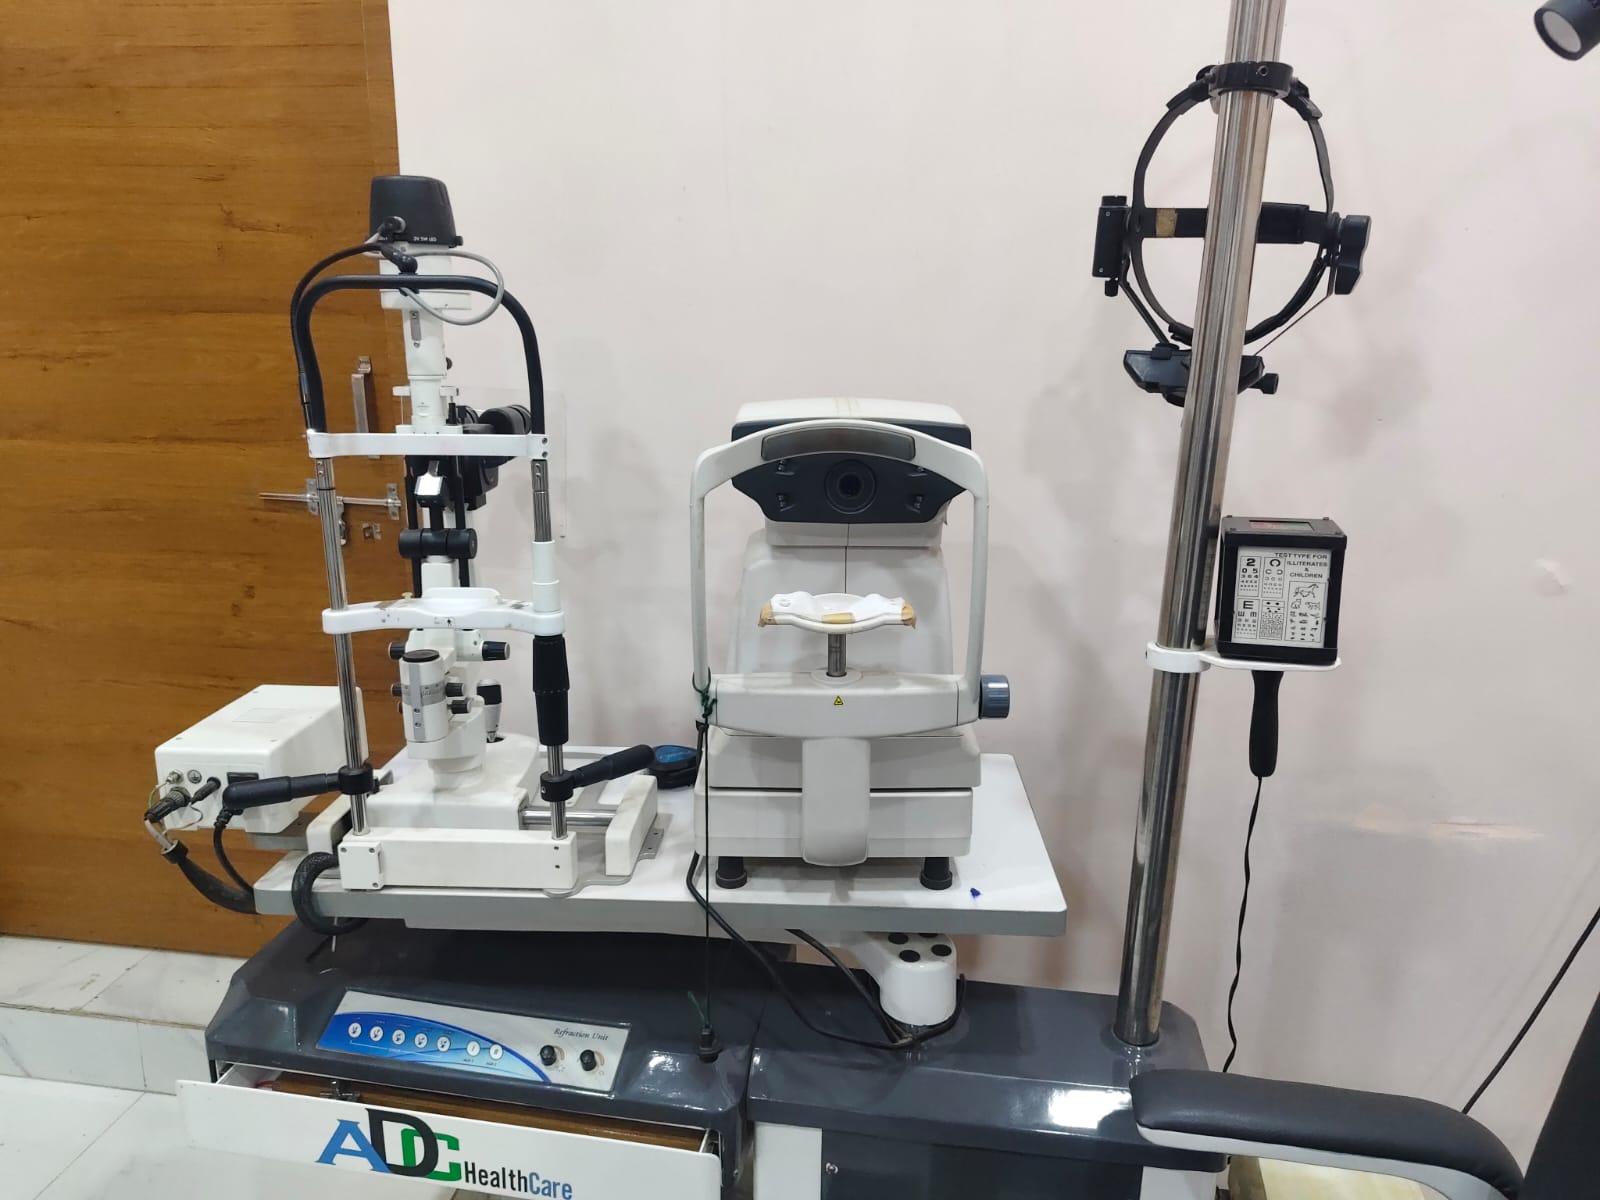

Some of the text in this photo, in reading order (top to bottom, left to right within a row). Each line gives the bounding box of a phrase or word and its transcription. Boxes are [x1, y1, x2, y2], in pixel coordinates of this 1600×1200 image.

[1246, 558, 1256, 567] 2
[553, 1027, 609, 1041] Refraction Unit
[314, 1107, 573, 1200] ADC HealthCare
